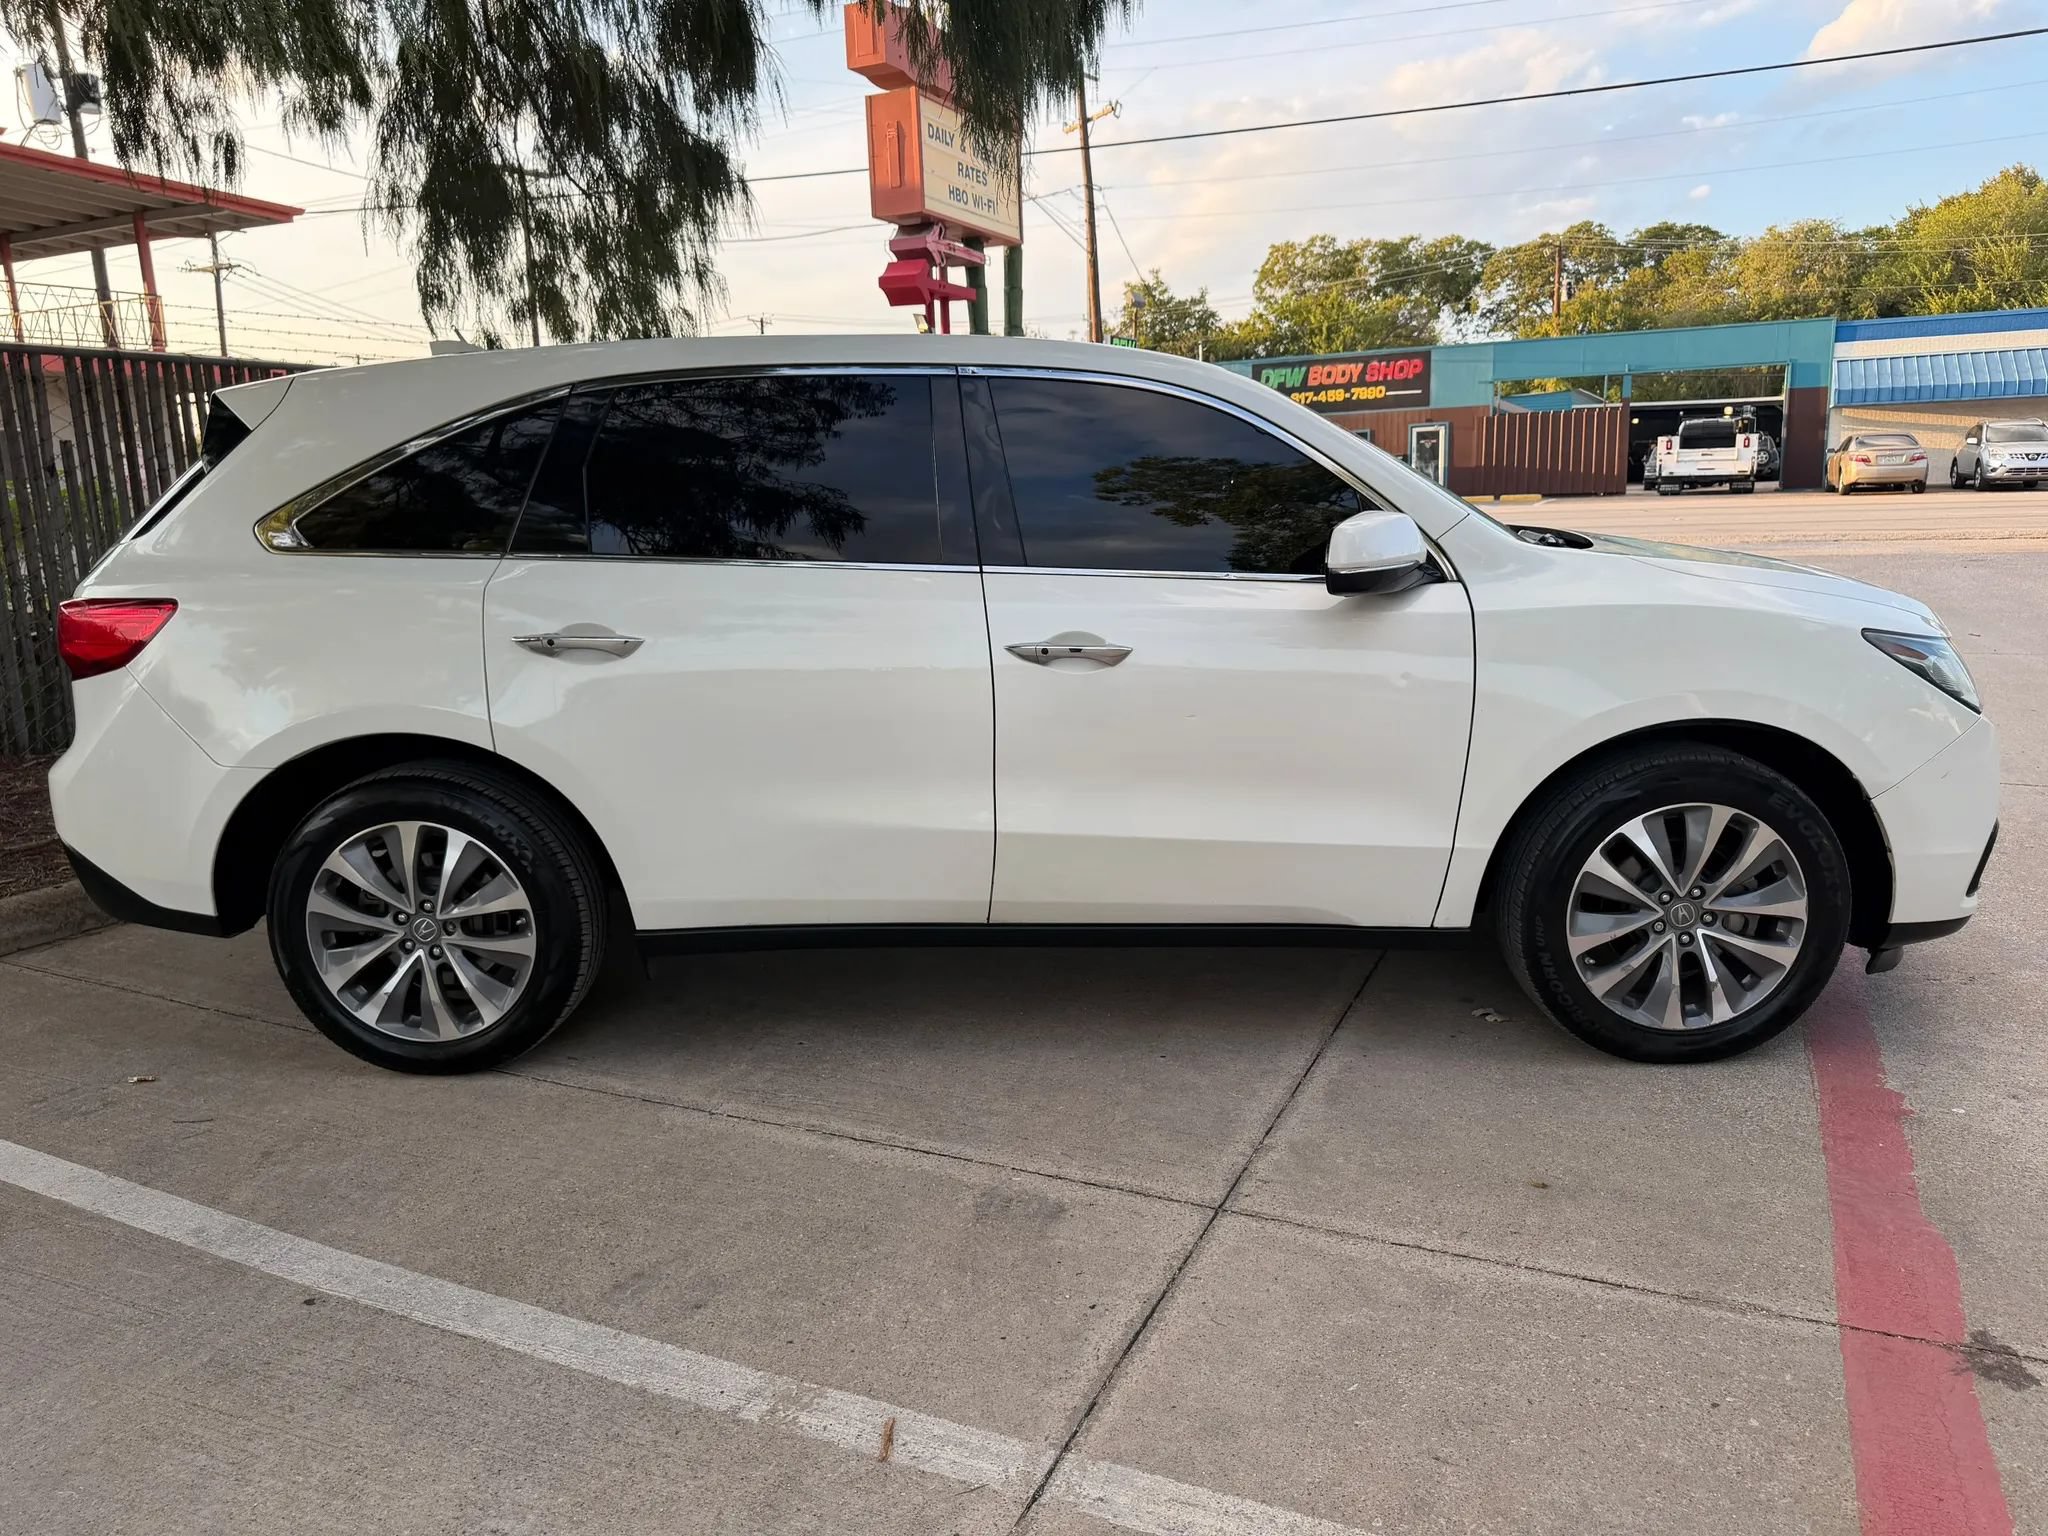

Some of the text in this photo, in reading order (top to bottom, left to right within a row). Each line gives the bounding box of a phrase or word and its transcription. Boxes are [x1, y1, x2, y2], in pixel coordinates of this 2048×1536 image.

[927, 122, 955, 148] DAILY
[957, 161, 988, 187] RATES
[948, 184, 996, 216] HBO WI-FI
[1261, 359, 1425, 390] DFW BODY SHOP
